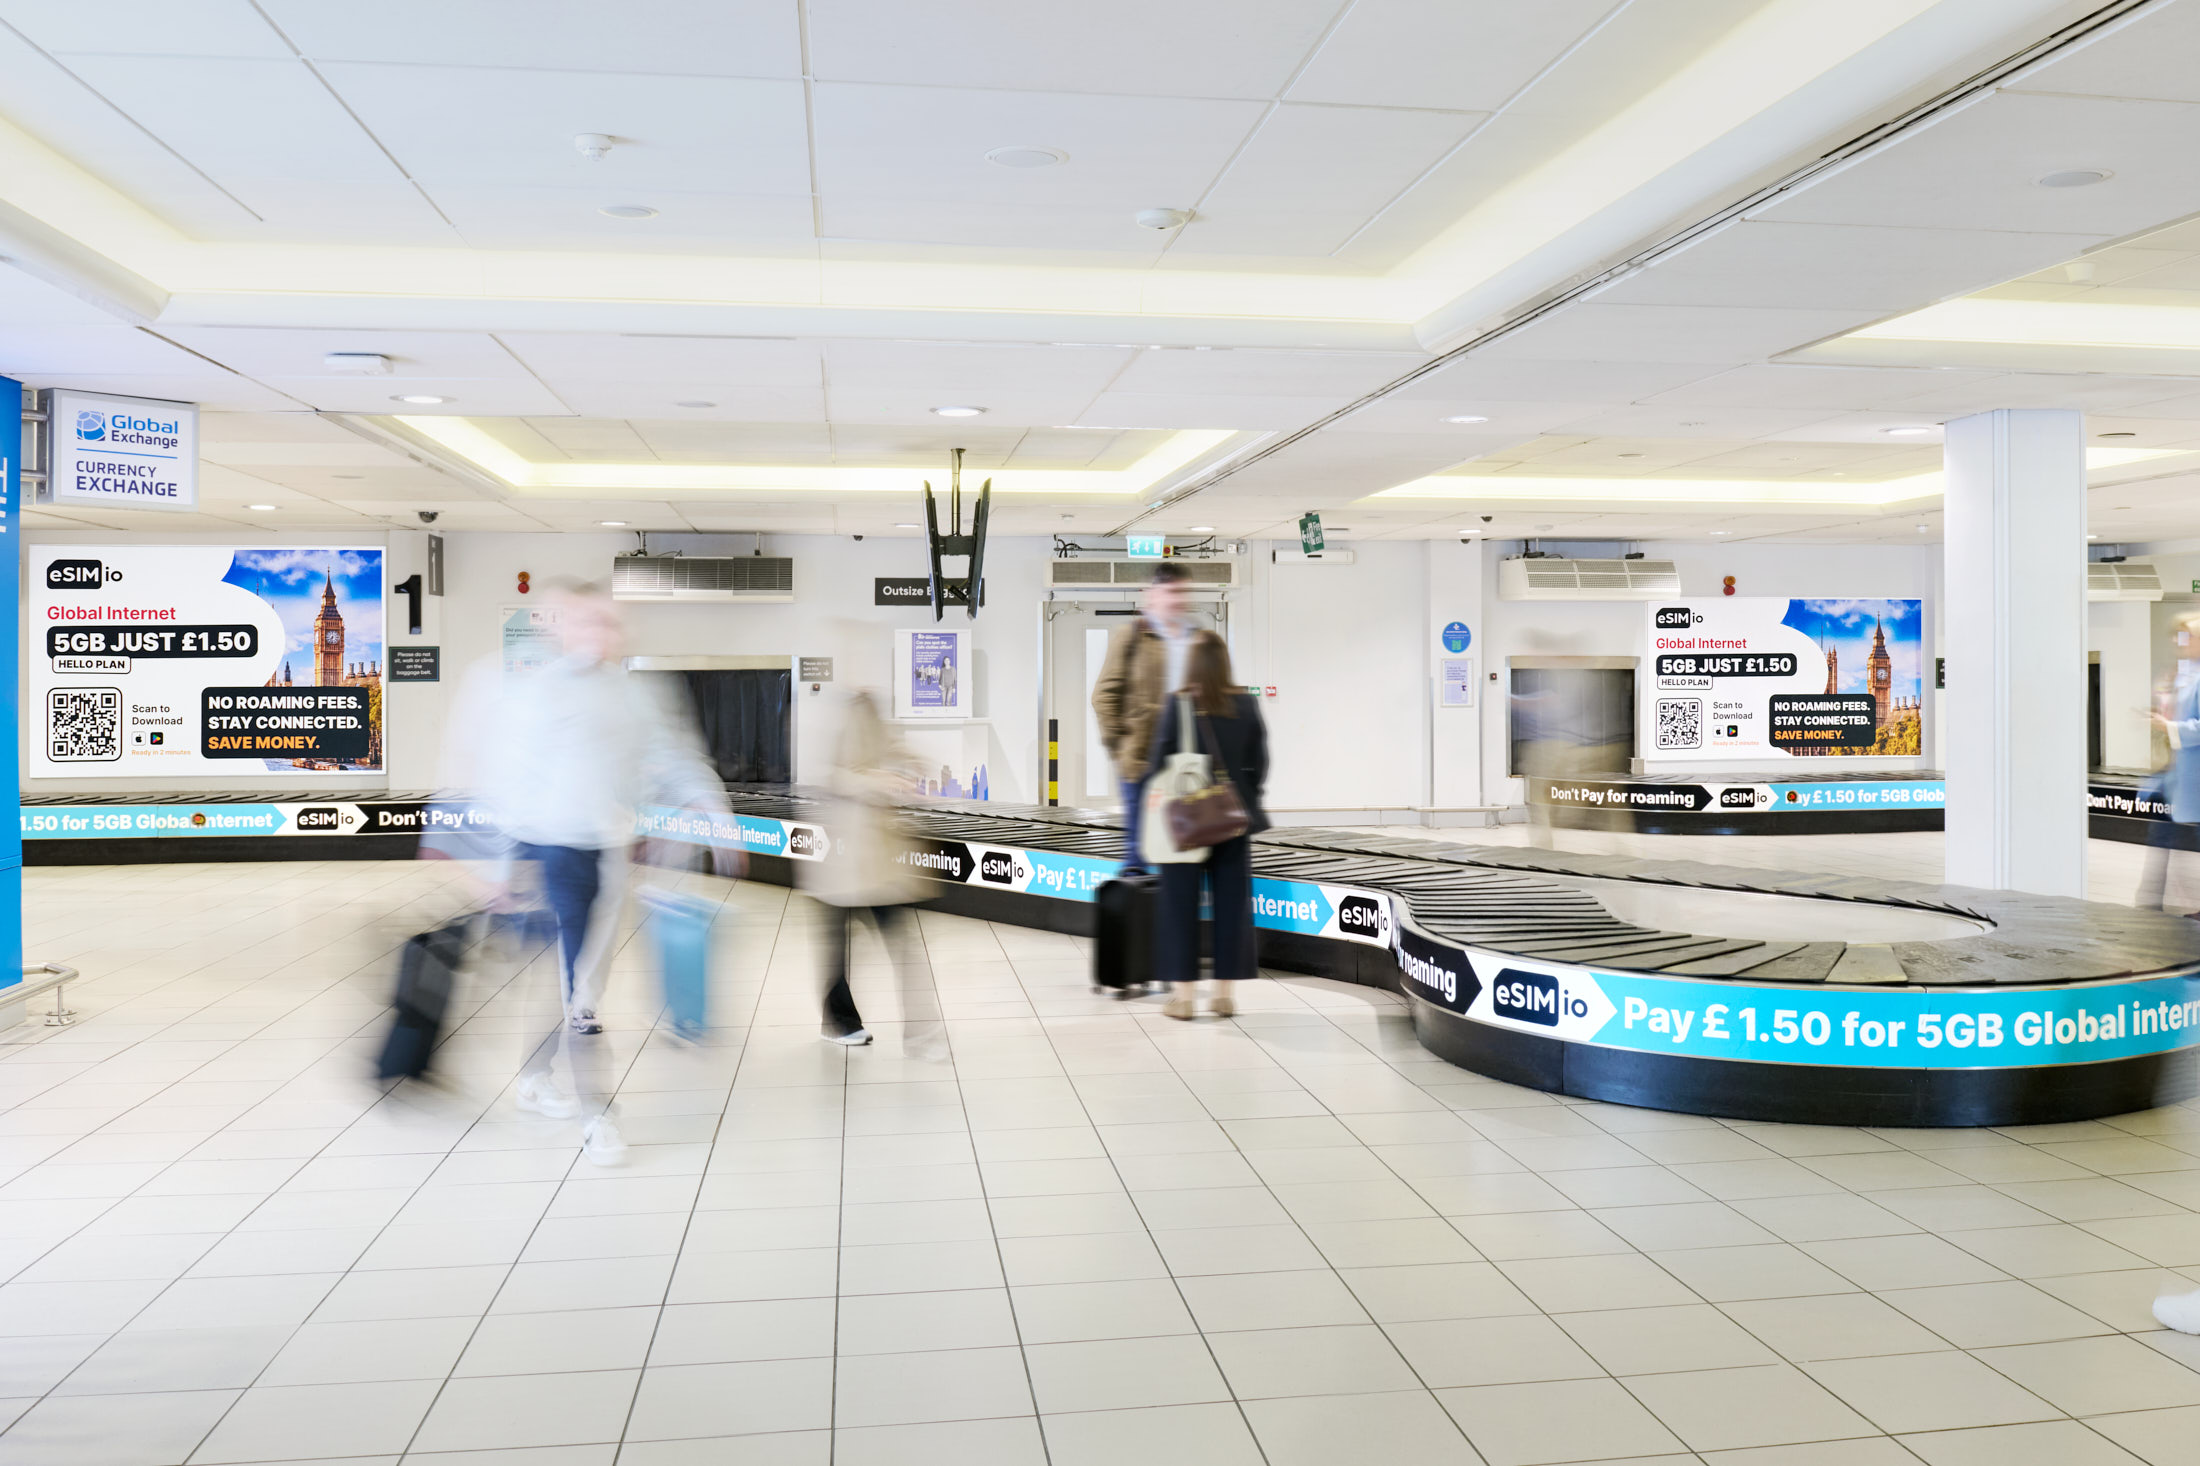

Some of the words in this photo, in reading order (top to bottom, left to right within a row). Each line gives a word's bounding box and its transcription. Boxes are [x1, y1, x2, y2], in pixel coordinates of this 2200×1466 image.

[111, 414, 178, 434] Global
[111, 430, 178, 449] Exchange
[76, 460, 157, 478] CURRENCY
[76, 475, 178, 497] EXCHANGE
[882, 585, 924, 596] Outsize
[394, 575, 422, 634] 1
[47, 606, 102, 620] Global
[107, 606, 176, 620] Internet
[54, 633, 106, 653] 5GB
[110, 632, 176, 652] JUST
[181, 631, 251, 651] £1.50
[1656, 638, 1695, 649] Global
[1698, 638, 1747, 649] Internet
[58, 660, 93, 669] HELLO
[96, 660, 125, 669] PLAN
[1662, 658, 1696, 673] 5GB
[1698, 658, 1743, 673] JUST
[1745, 657, 1792, 673] £1.50
[132, 704, 157, 713] Scan
[160, 704, 170, 713] to
[208, 696, 233, 709] NO
[236, 696, 315, 709] ROAMING
[318, 696, 362, 709] FEES.
[1713, 701, 1733, 709] Scan
[1774, 702, 1790, 712] NO
[1792, 701, 1841, 712] ROAMING
[1842, 701, 1871, 712] FEES.
[132, 716, 183, 726] Download
[208, 716, 253, 730] STAY
[255, 716, 362, 729] CONNECTED.
[1713, 712, 1753, 720] Download
[1774, 716, 1802, 726] STAY
[1803, 715, 1871, 726] CONNECTED.
[208, 736, 253, 750] SAVE
[255, 736, 321, 749] MONEY.
[1774, 730, 1802, 740] SAVE
[1803, 730, 1845, 740] MONEY.
[1581, 788, 1605, 805] Pay
[1606, 789, 1628, 803] for
[1630, 790, 1695, 808] roaming
[1812, 790, 1823, 804] £
[1824, 790, 1853, 804] 1.50
[1857, 789, 1879, 803] for
[1880, 789, 1910, 803] 5GB
[1912, 788, 1945, 802] Glob
[2113, 795, 2134, 814] Pay
[2135, 797, 2152, 813] for
[61, 814, 89, 830] for
[93, 814, 133, 830] 5GB
[199, 813, 273, 829] nternet
[431, 810, 464, 829] Pay
[467, 809, 494, 825] for
[638, 812, 654, 831] Pay
[660, 816, 678, 833] 1.50
[678, 817, 691, 834] for
[692, 820, 712, 837] 5GB
[712, 822, 741, 841] Global
[742, 825, 781, 847] internet
[909, 850, 961, 877] roaming
[1037, 864, 1064, 891] Pay
[1065, 867, 1077, 889] £
[1251, 893, 1319, 922] nternet
[1404, 951, 1457, 1003] roaming
[1624, 996, 1696, 1044] Pay
[1702, 1003, 1730, 1040] £
[1738, 1007, 1831, 1046] 1.50
[1841, 1011, 1906, 1048] for
[1917, 1013, 2005, 1049] 5GB
[2014, 1004, 2126, 1046] Global
[2133, 1000, 2200, 1036] intern
